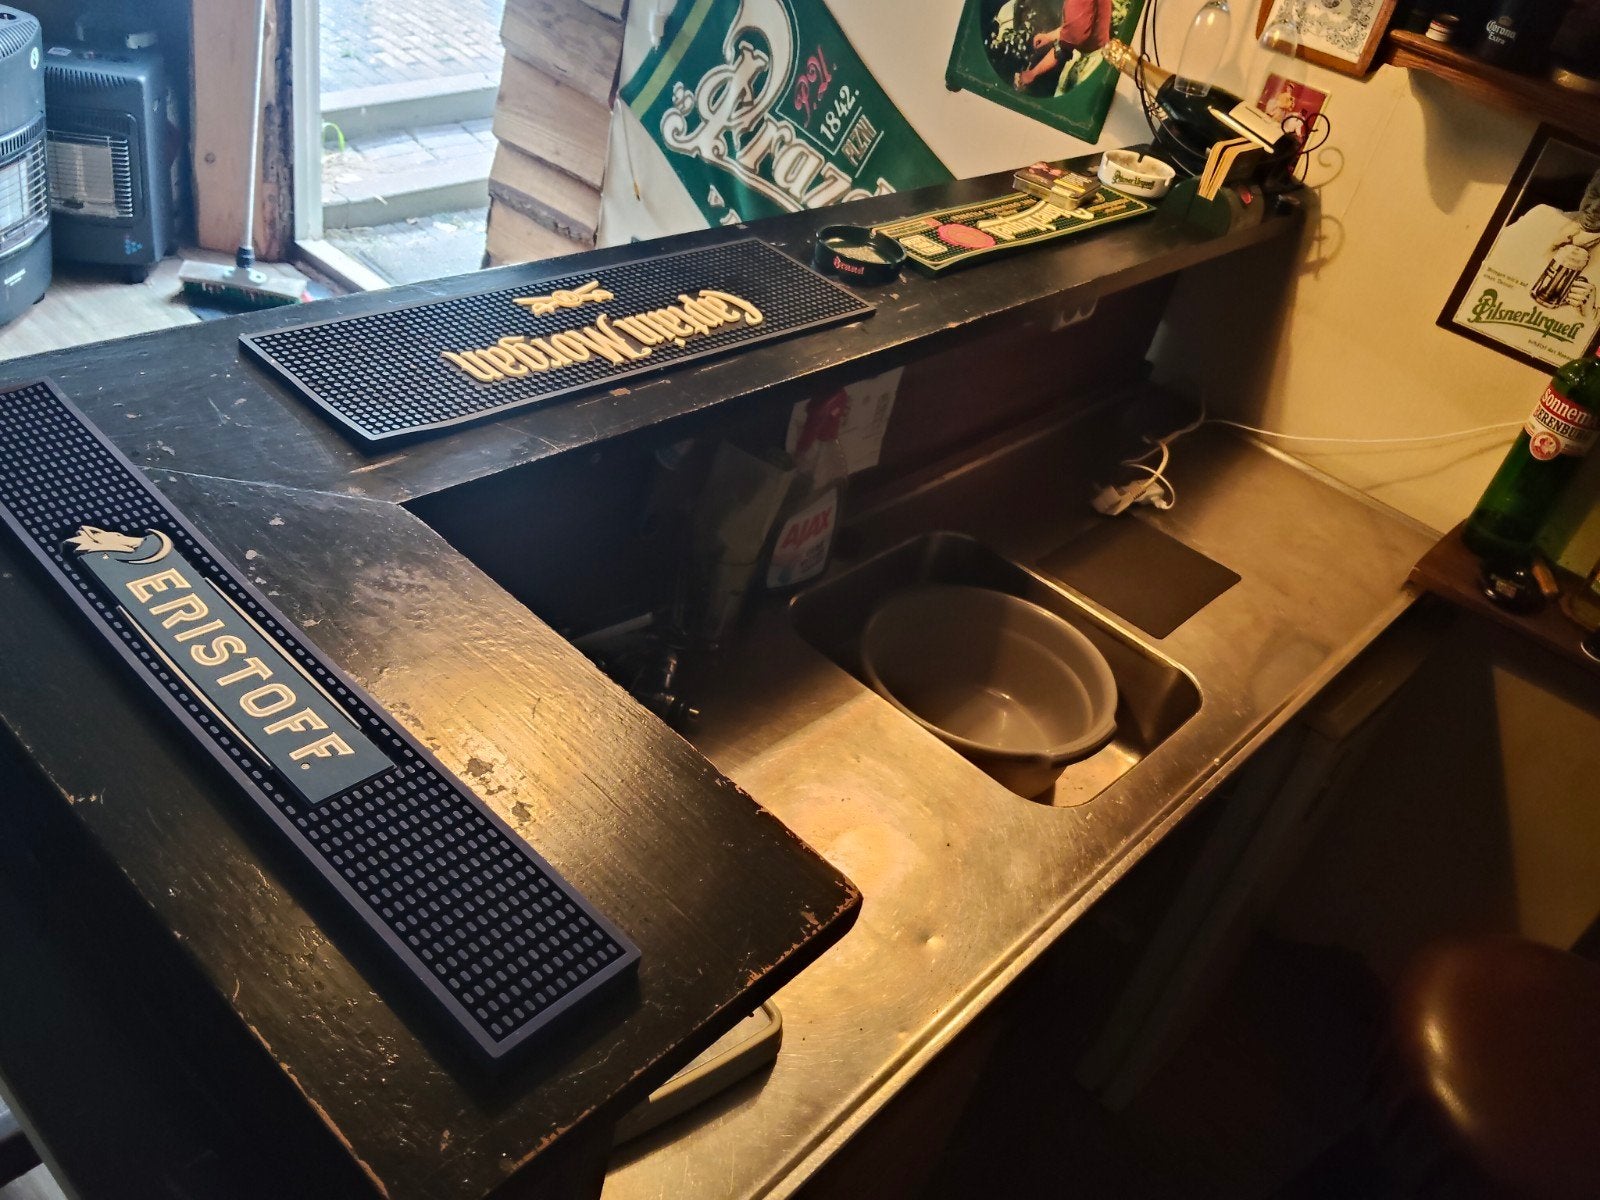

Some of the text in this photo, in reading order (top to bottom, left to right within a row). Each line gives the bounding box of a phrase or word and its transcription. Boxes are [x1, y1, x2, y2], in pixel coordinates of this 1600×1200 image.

[1486, 20, 1517, 40] Corona
[1488, 31, 1506, 45] Extra
[441, 289, 764, 384] Captain Morgan
[1467, 288, 1585, 341] Pilsner Urquell
[781, 505, 833, 550] AJAX
[125, 567, 356, 762] ERISTOFF
